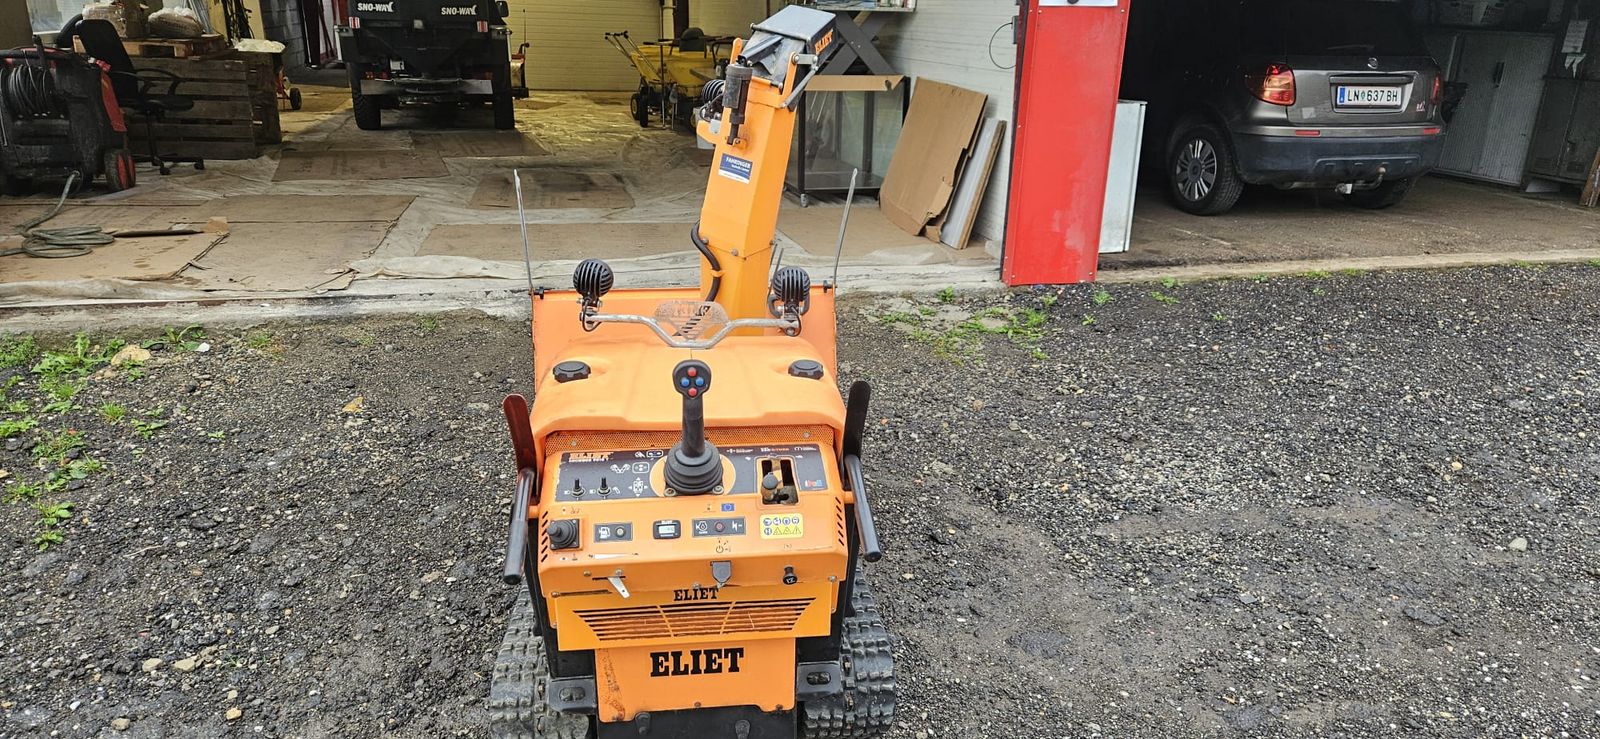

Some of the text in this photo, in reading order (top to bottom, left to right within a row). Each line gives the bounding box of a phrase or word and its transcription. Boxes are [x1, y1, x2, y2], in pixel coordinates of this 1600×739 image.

[357, 2, 394, 12] SNO-WAY
[441, 5, 477, 15] SNO-WAY
[814, 28, 834, 54] ELIET
[1347, 89, 1398, 102] LN 637 BH
[673, 588, 719, 601] ELIET
[650, 647, 744, 677] ELIET
